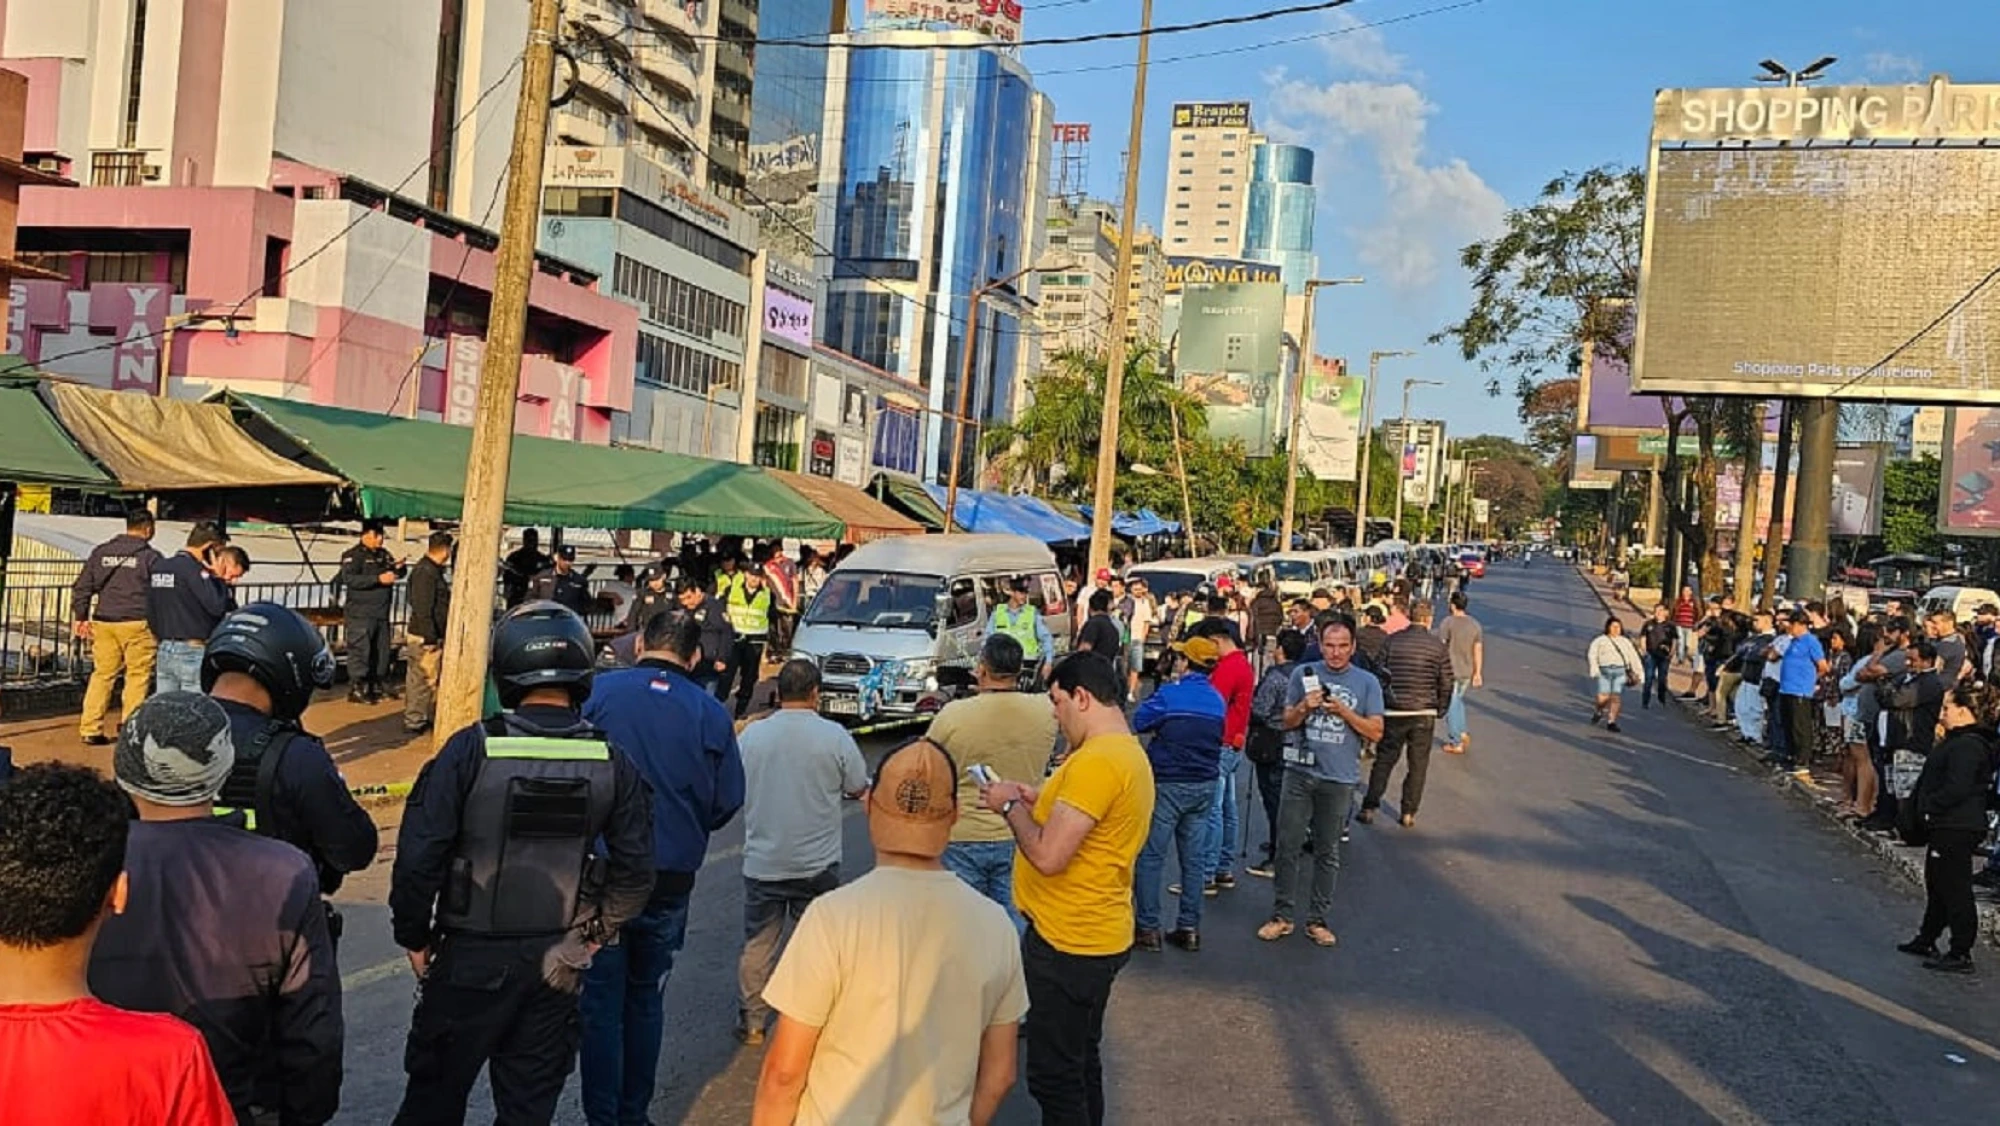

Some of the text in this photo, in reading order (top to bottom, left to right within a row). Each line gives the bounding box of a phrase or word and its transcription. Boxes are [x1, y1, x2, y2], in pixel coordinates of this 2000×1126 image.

[1194, 103, 1246, 116] Brands
[1682, 96, 1889, 133] SHOPPING
[1193, 117, 1215, 128] For
[118, 288, 159, 396] YAN
[1733, 361, 1803, 378] Shopping
[1808, 363, 1843, 376] Paris
